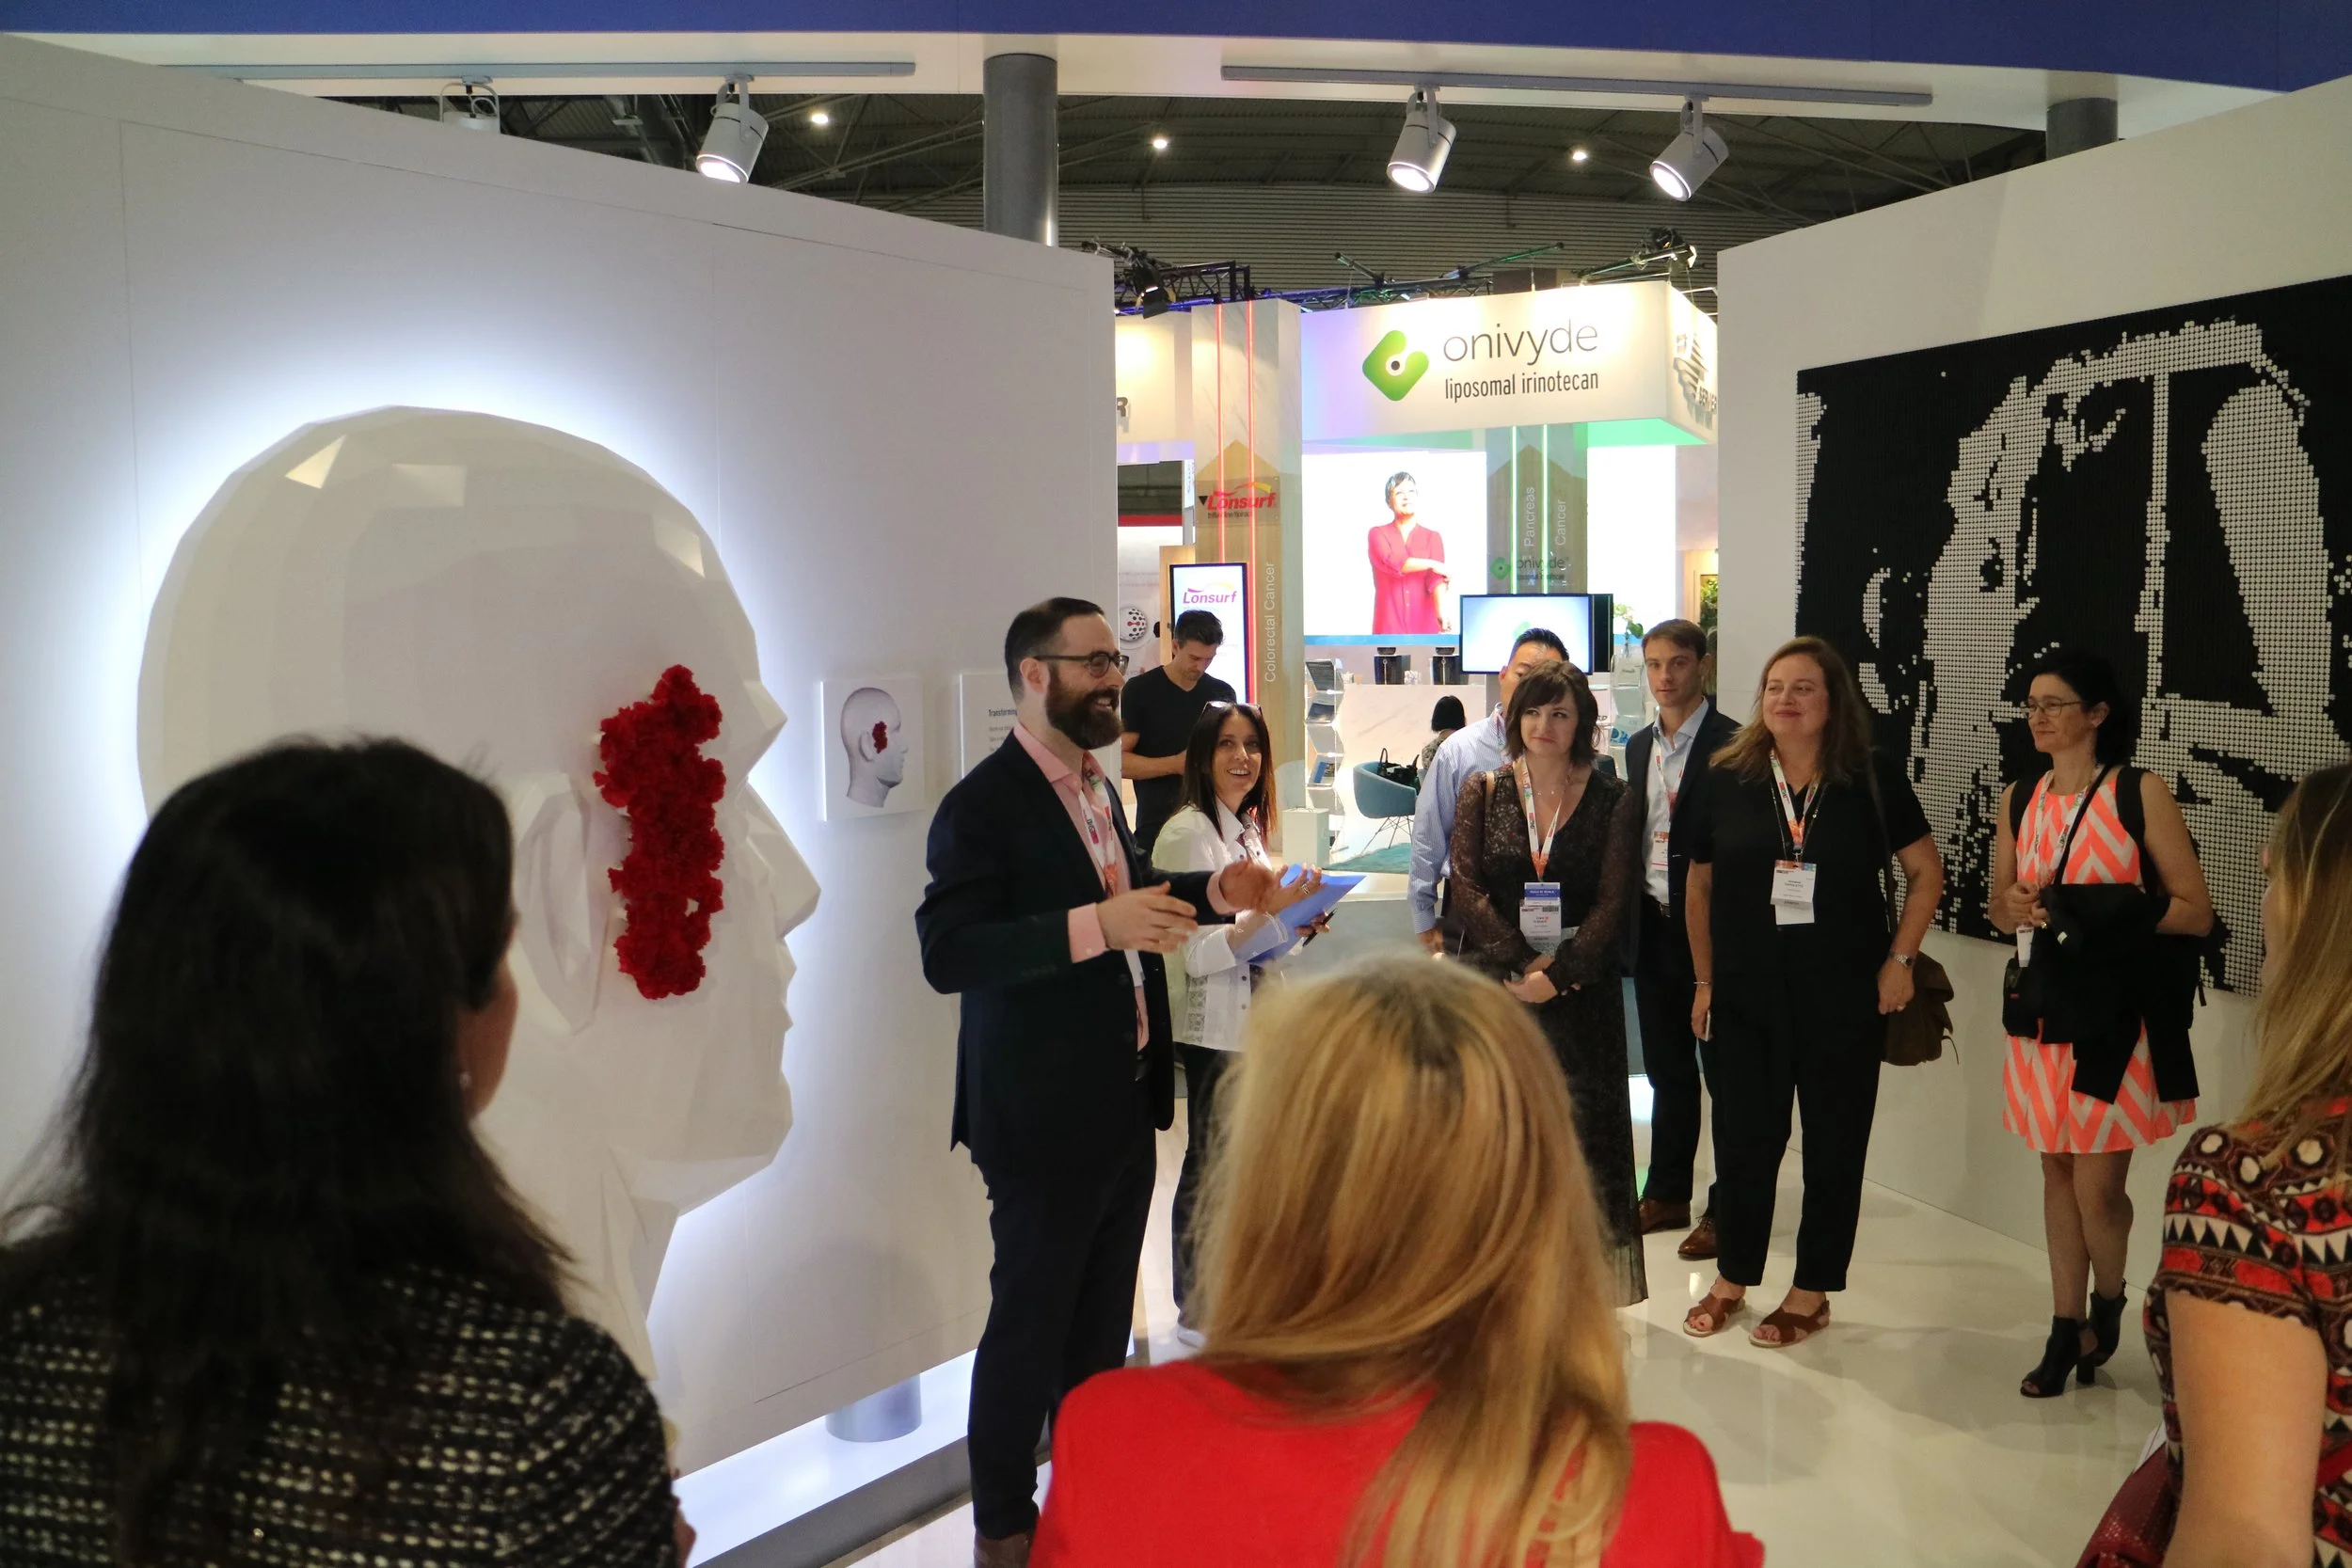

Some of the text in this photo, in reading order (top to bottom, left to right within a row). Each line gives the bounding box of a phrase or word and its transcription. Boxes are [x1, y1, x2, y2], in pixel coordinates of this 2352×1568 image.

[1443, 317, 1597, 366] onivyde
[1445, 371, 1598, 404] liposomal irinotecan
[1207, 492, 1277, 511] Lonsurf
[1524, 486, 1535, 546] Pancreas
[1555, 499, 1566, 546] Cancer
[1183, 591, 1238, 604] Lonsurf
[1264, 562, 1276, 682] Colorectal Cancer
